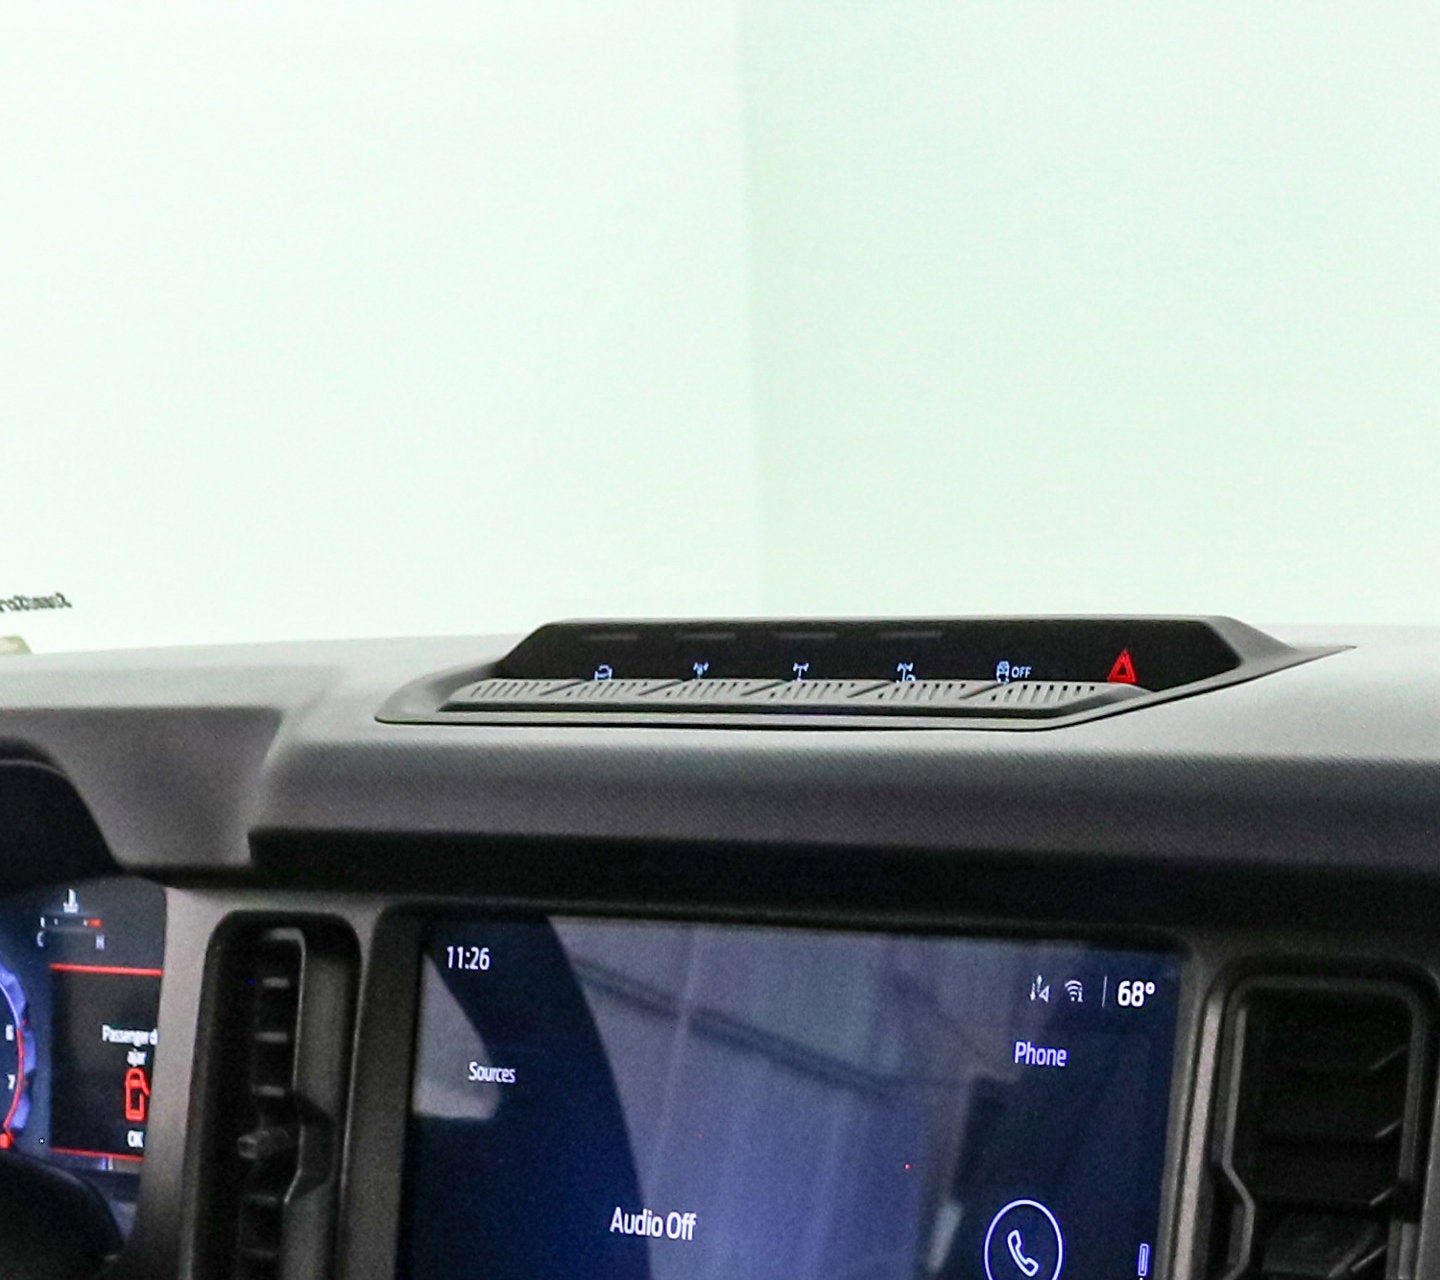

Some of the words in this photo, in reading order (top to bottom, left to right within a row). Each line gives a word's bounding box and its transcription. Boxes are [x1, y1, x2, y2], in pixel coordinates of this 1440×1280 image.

[1010, 664, 1033, 681] OFF
[446, 945, 491, 971] 11:26
[1117, 980, 1156, 1008] 68°
[1014, 1040, 1069, 1067] Phone
[467, 1061, 516, 1084] Sources
[126, 1128, 145, 1149] OK
[609, 1206, 665, 1239] Audio
[665, 1210, 698, 1243] Off
